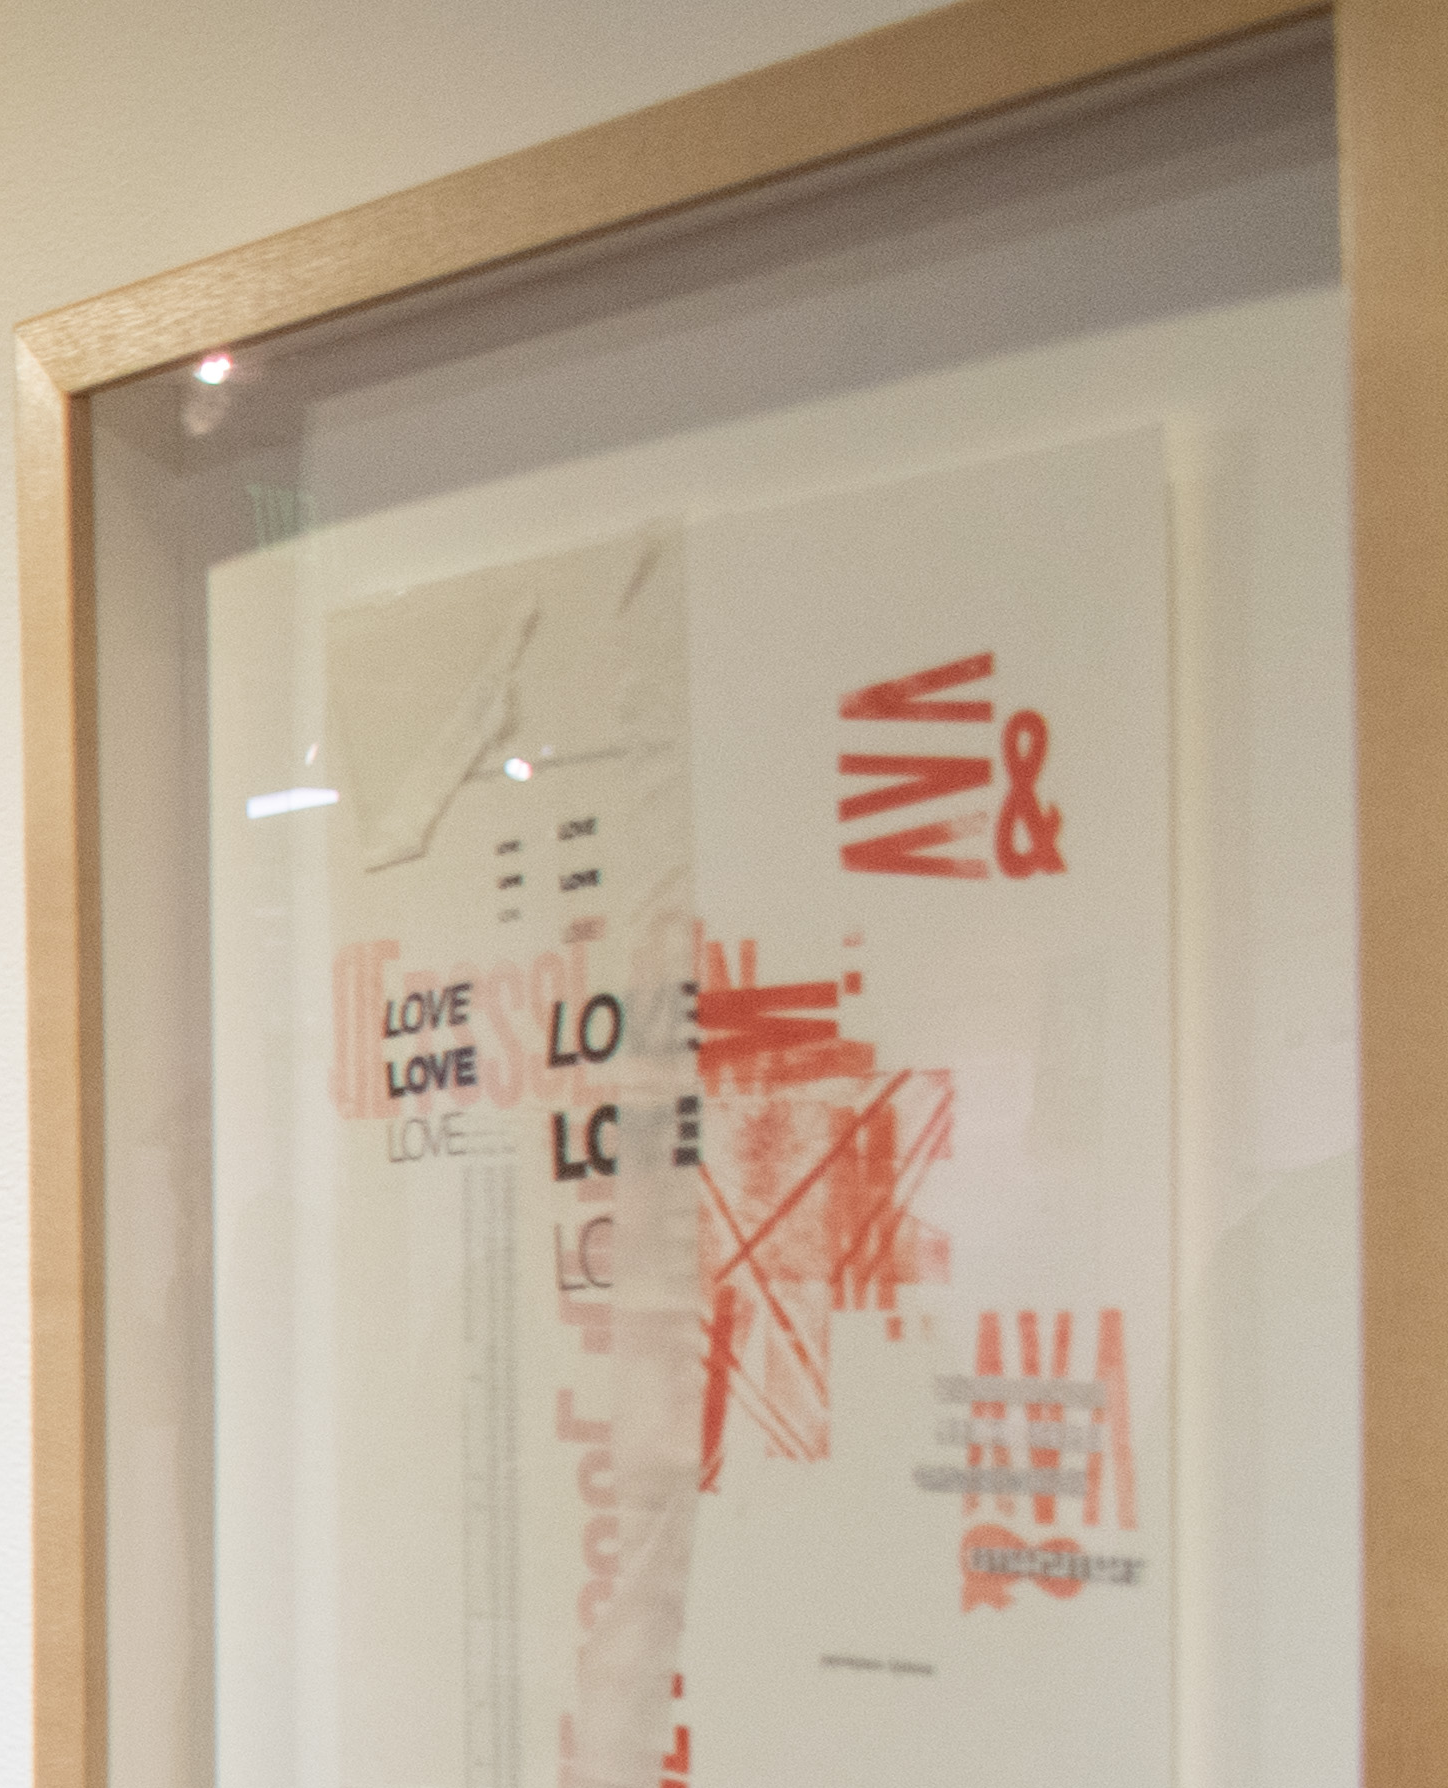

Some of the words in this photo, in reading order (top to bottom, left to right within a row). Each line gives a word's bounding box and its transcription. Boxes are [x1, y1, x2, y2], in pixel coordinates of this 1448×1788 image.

[383, 982, 473, 1039] LOVE
[387, 1046, 478, 1099] LOVE
[387, 1111, 466, 1163] LOVE
